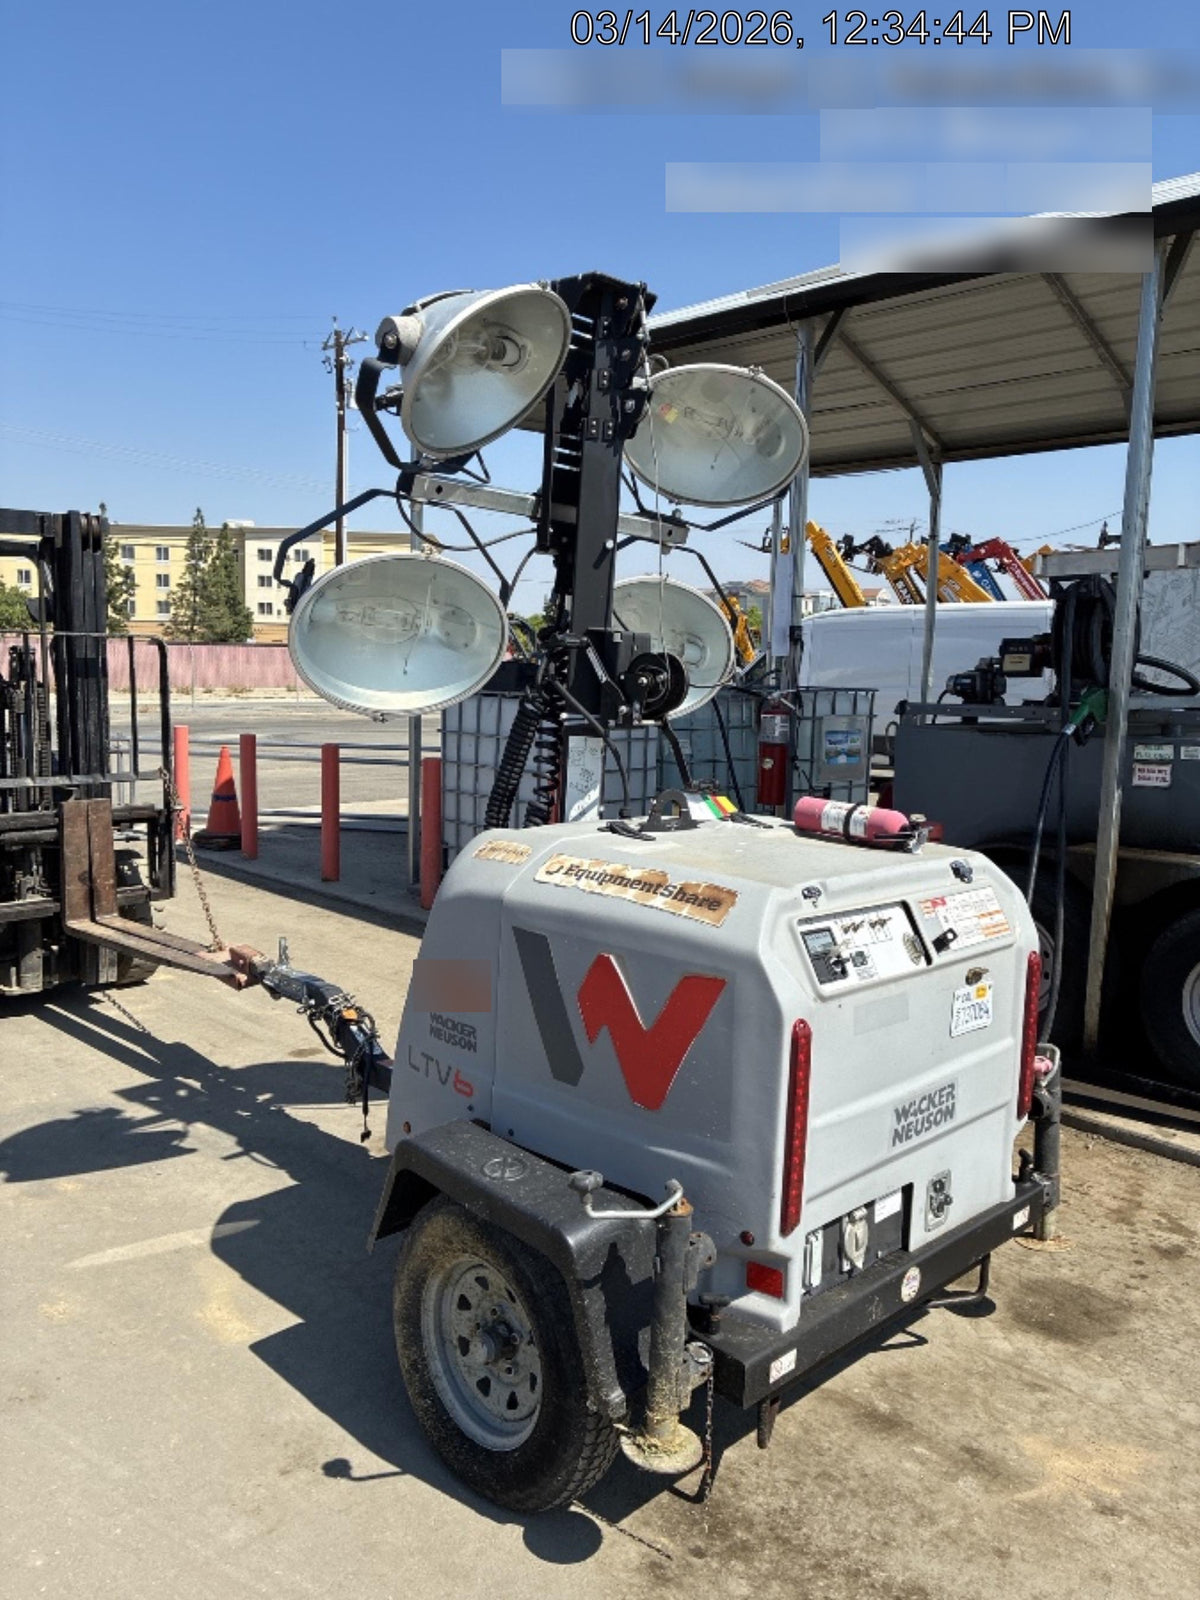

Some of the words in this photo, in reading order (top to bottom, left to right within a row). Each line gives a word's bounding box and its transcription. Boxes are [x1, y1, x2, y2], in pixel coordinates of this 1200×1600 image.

[564, 863, 722, 912] EquipmentShare
[429, 1012, 477, 1040] WACKER
[429, 1024, 477, 1054] NEUSON
[892, 1102, 955, 1147] NEUSON
[895, 1082, 955, 1126] WACKER
